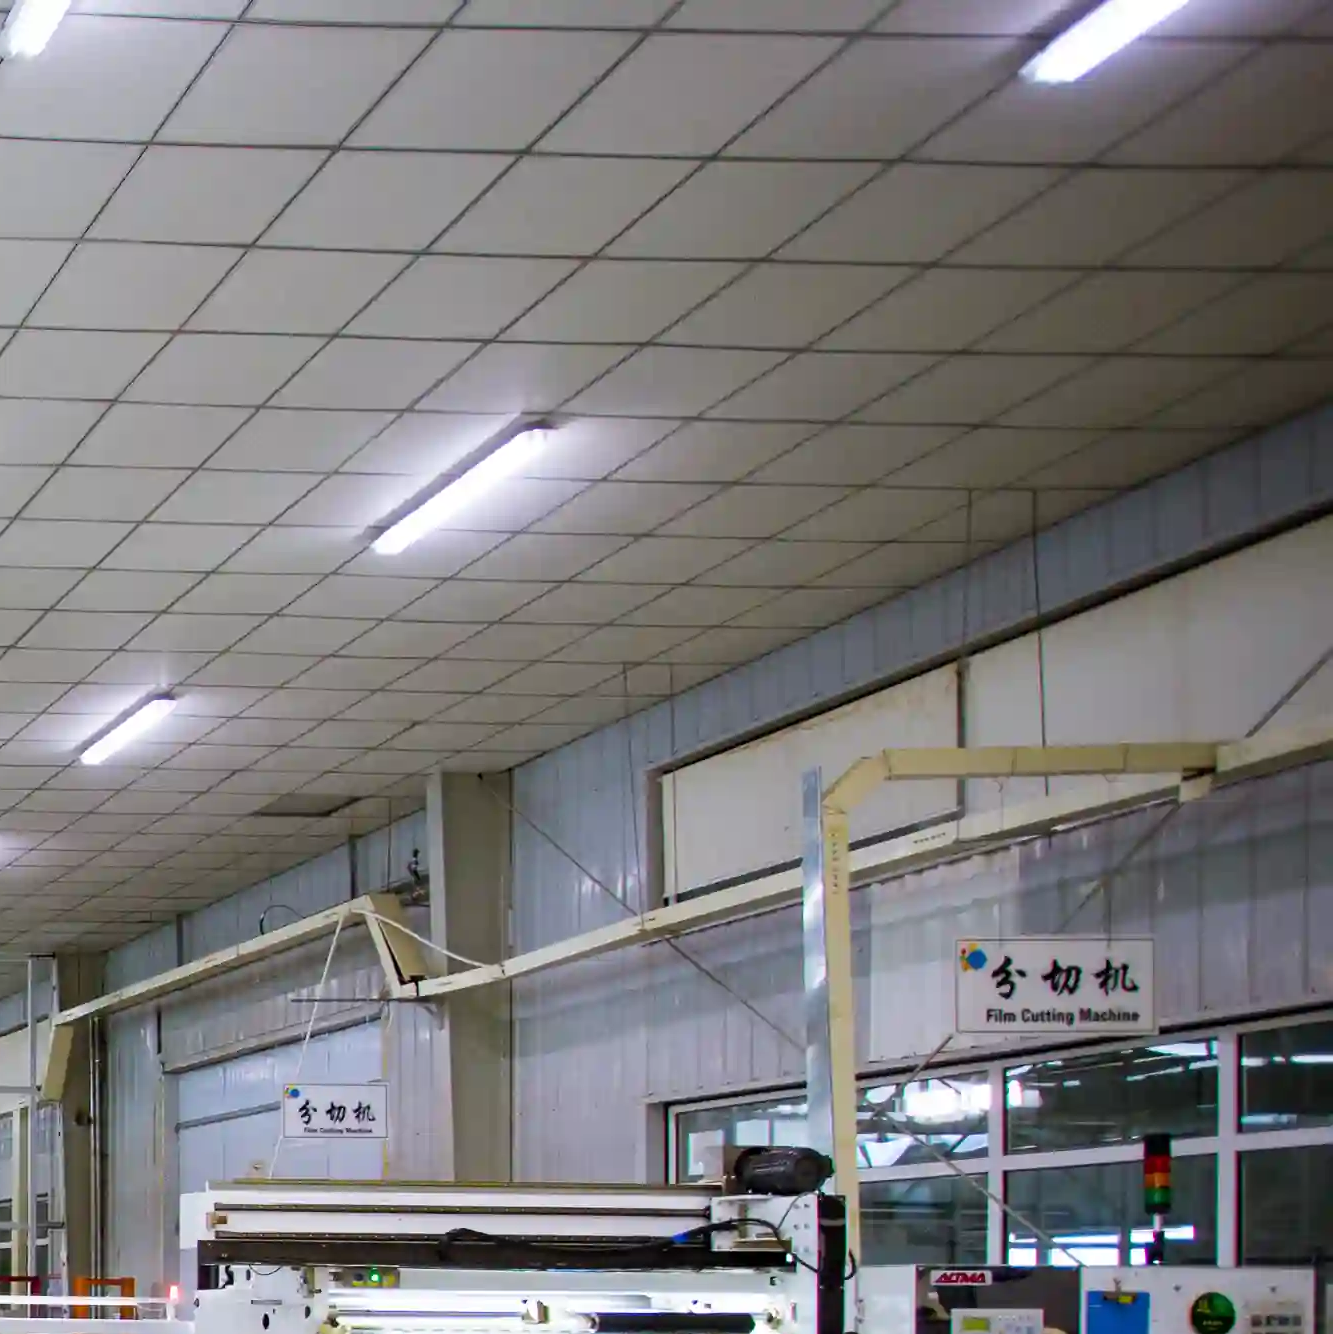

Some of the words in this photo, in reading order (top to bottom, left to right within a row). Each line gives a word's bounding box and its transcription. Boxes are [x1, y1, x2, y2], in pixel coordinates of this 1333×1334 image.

[991, 955, 1140, 1000] 分切机
[986, 1008, 1017, 1023] Film
[1021, 1008, 1075, 1026] Cutting
[1079, 1007, 1141, 1024] Machine
[298, 1099, 376, 1125] 分切机
